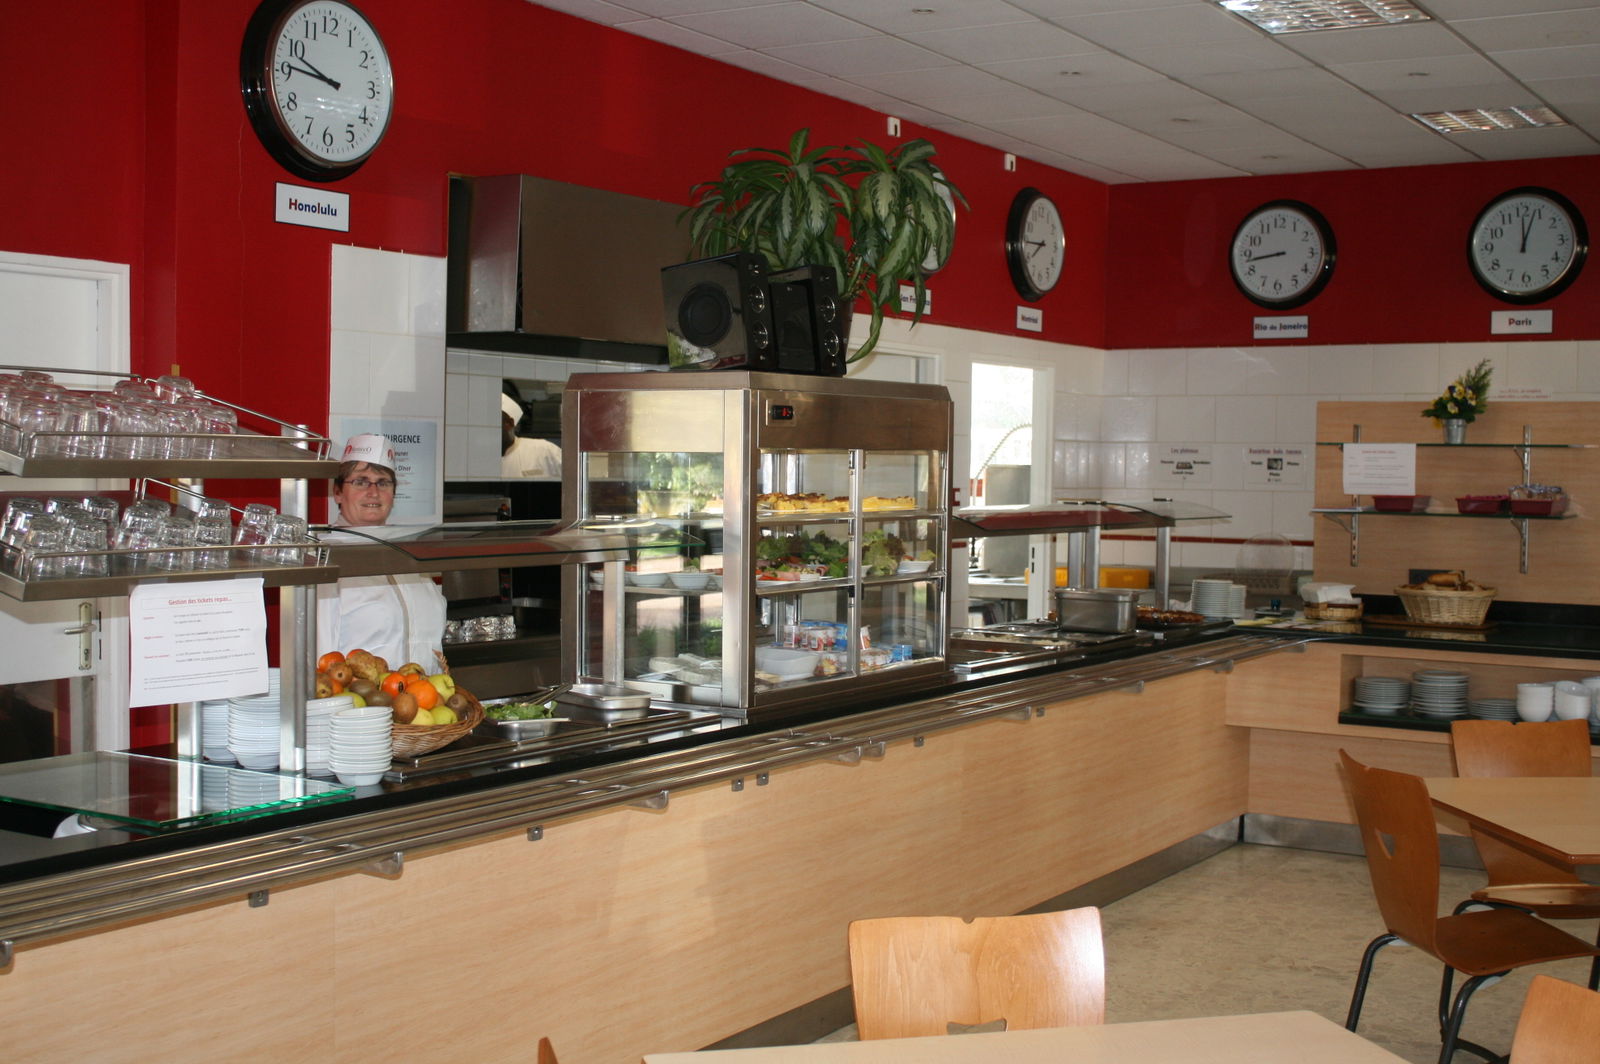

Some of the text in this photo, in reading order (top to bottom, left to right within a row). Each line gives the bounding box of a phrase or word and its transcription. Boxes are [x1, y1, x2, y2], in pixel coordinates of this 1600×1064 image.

[304, 20, 318, 41] 11
[322, 16, 339, 37] 12
[289, 38, 305, 59] 10
[359, 50, 369, 69] 2
[281, 61, 292, 81] 9
[367, 81, 376, 99] 3
[286, 92, 298, 111] 8
[358, 105, 369, 125] 4
[304, 116, 314, 135] 7
[322, 126, 334, 146] 6
[346, 124, 355, 143] 5
[289, 198, 337, 216] Honolulu
[1516, 205, 1530, 218] 12
[1274, 217, 1286, 229] 12
[1501, 213, 1512, 225] 11
[1549, 217, 1558, 229] 2
[1260, 223, 1270, 234] 11
[1490, 227, 1504, 240] 10
[1249, 235, 1261, 247] 10
[1301, 231, 1309, 242] 2
[1557, 234, 1565, 246] 3
[1243, 249, 1252, 259] 9
[1308, 247, 1315, 258] 3
[1484, 242, 1494, 253] 9
[1551, 250, 1560, 263] 4
[1247, 264, 1256, 276] 8
[1301, 263, 1309, 274] 4
[1491, 258, 1500, 271] 8
[1541, 264, 1550, 277] 5
[1260, 275, 1268, 287] 7
[1291, 274, 1299, 287] 5
[1506, 268, 1514, 281] 7
[1521, 272, 1531, 284] 6
[1273, 279, 1282, 291] 6
[1254, 323, 1267, 331] Rio
[1279, 322, 1307, 331] Janeiro
[1508, 317, 1532, 326] Paris
